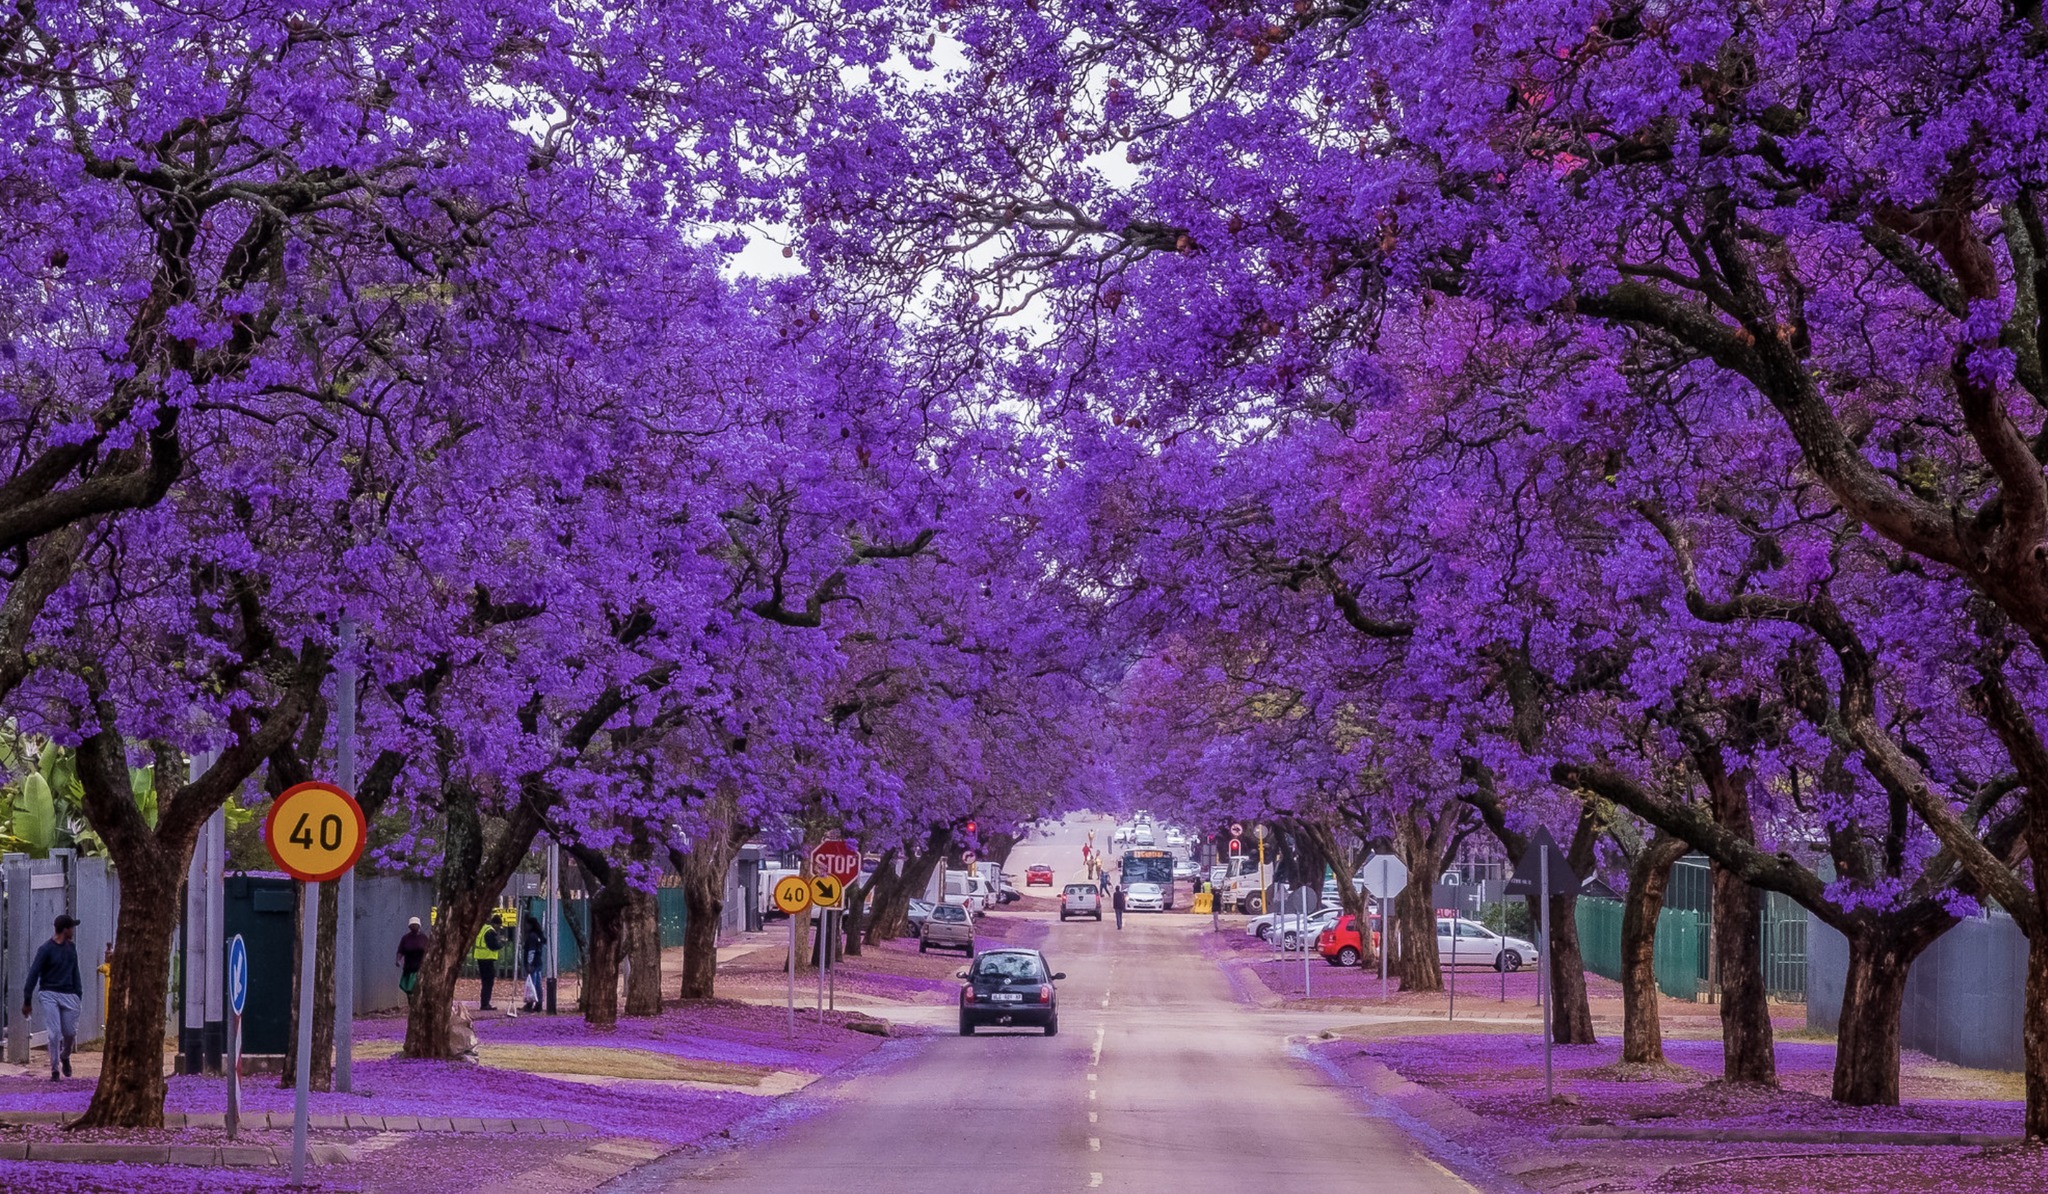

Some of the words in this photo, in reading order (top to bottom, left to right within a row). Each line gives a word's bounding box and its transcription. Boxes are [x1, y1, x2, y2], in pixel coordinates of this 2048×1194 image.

[289, 813, 342, 851] 40
[815, 853, 857, 876] STOP
[783, 887, 804, 902] 40
